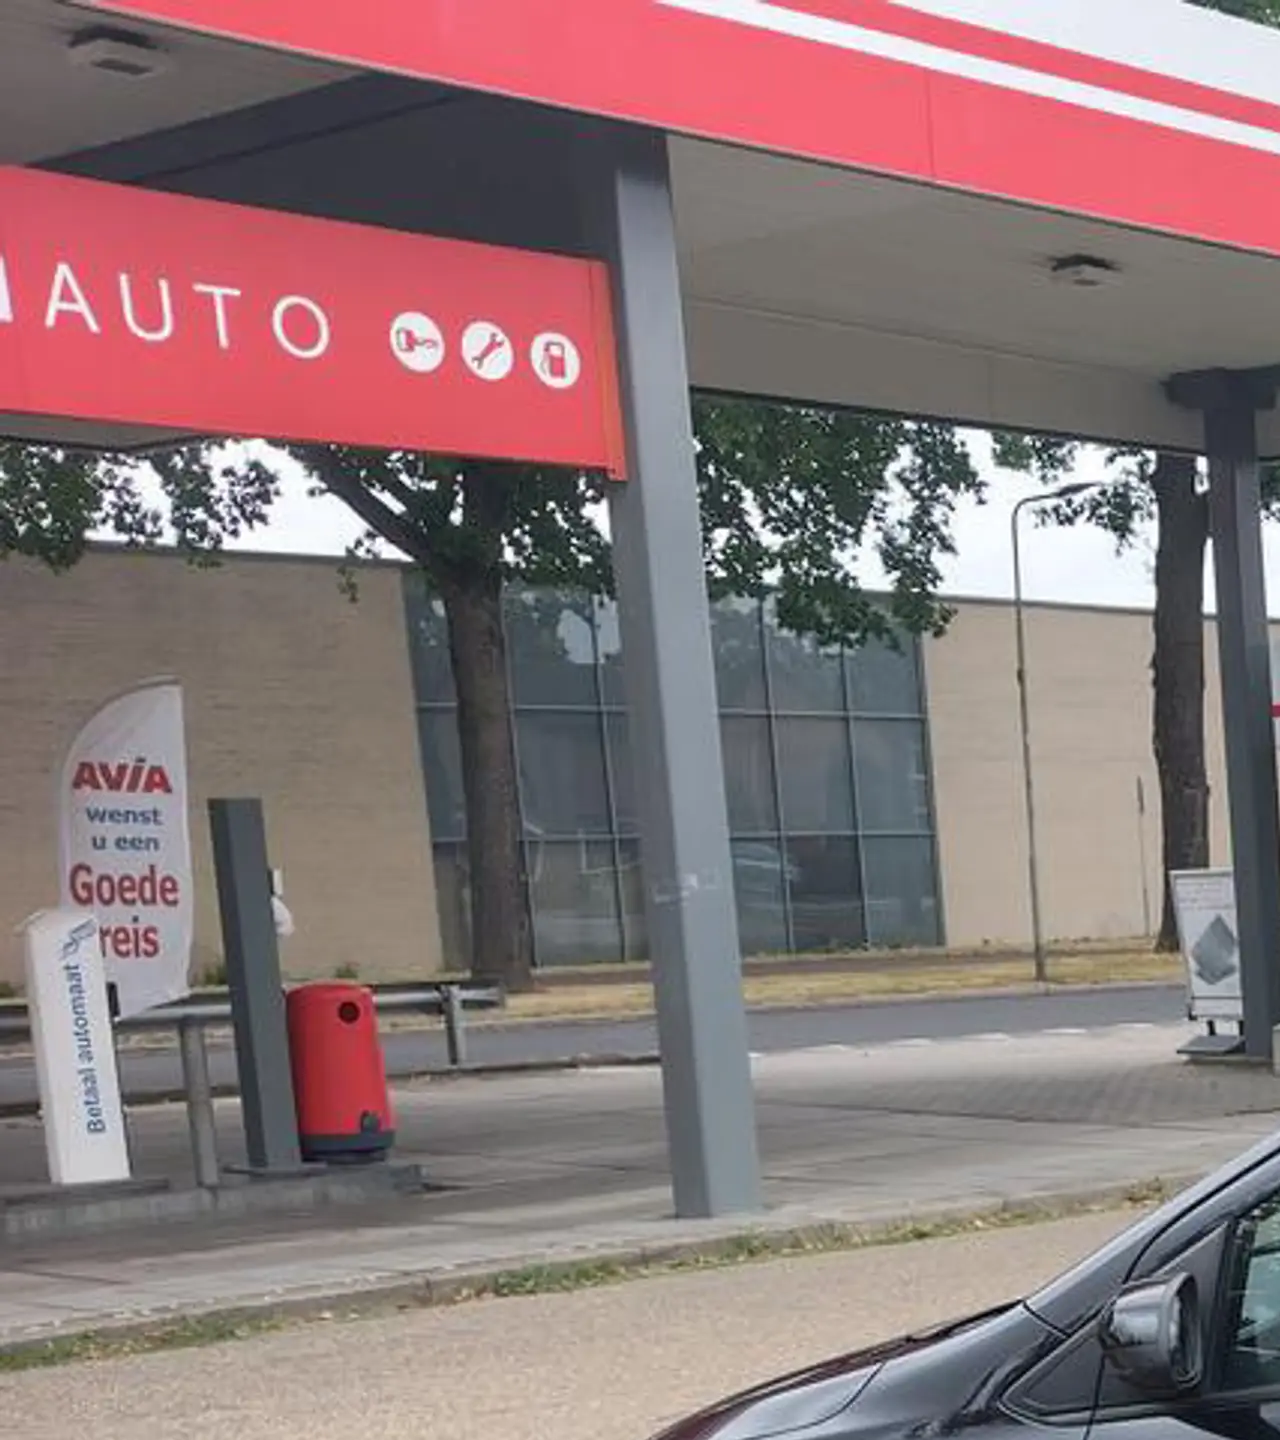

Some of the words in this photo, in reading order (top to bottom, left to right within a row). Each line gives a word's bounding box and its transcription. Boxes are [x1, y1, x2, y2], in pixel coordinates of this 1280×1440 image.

[0, 257, 330, 359] AUTO
[86, 807, 163, 826] wenst
[92, 836, 106, 851] u
[114, 836, 160, 852] een
[70, 862, 179, 907] Goede
[99, 915, 160, 959] reis
[63, 963, 95, 1065] automaat
[77, 1068, 106, 1135] Betaal
